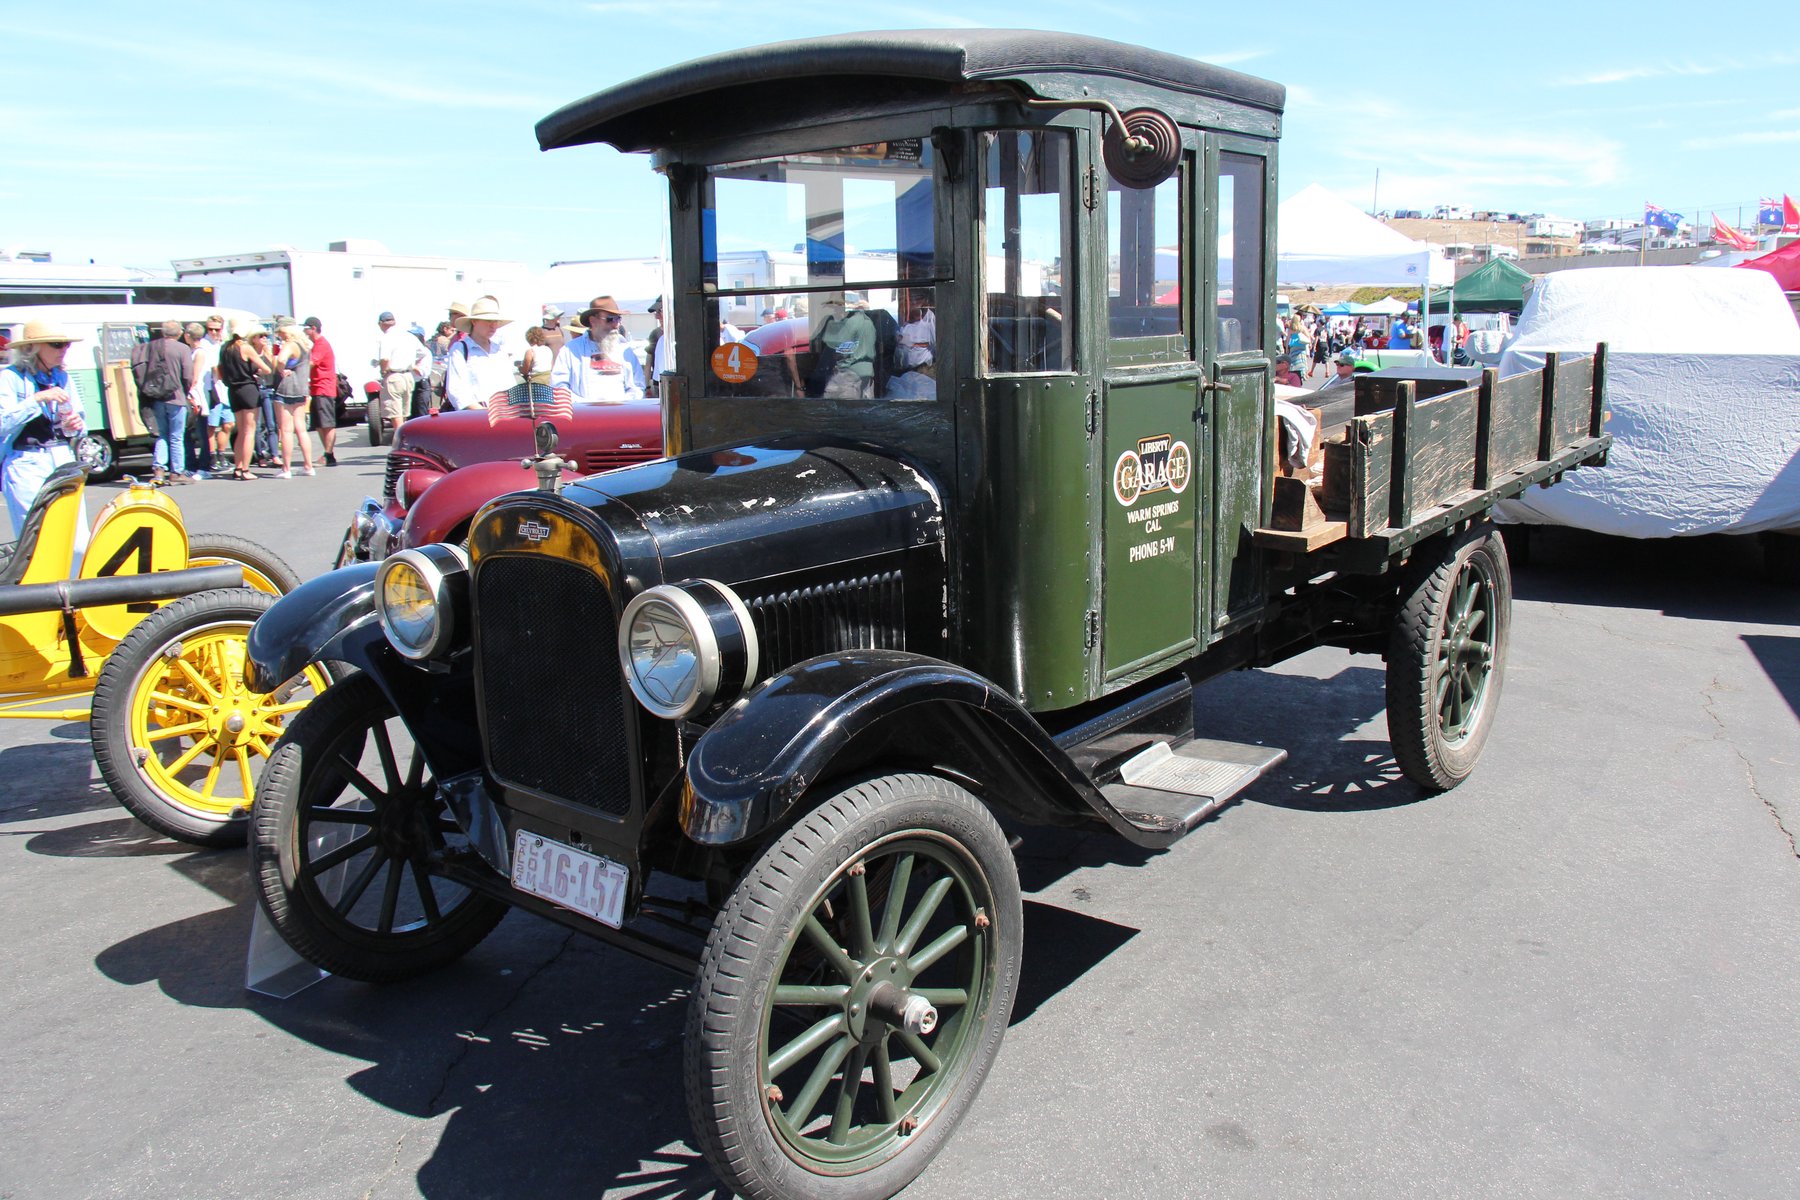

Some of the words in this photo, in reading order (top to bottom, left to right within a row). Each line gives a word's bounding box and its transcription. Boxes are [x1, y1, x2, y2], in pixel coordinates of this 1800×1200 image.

[728, 346, 741, 373] 4
[1140, 439, 1169, 455] LIBERTY
[1120, 456, 1185, 490] GARAGE
[1127, 506, 1152, 524] WARM
[1152, 500, 1180, 518] SPRINGS
[1129, 540, 1158, 563] PHONE
[1159, 536, 1176, 554] 5-W
[97, 526, 171, 613] 4
[816, 815, 889, 883] CORD
